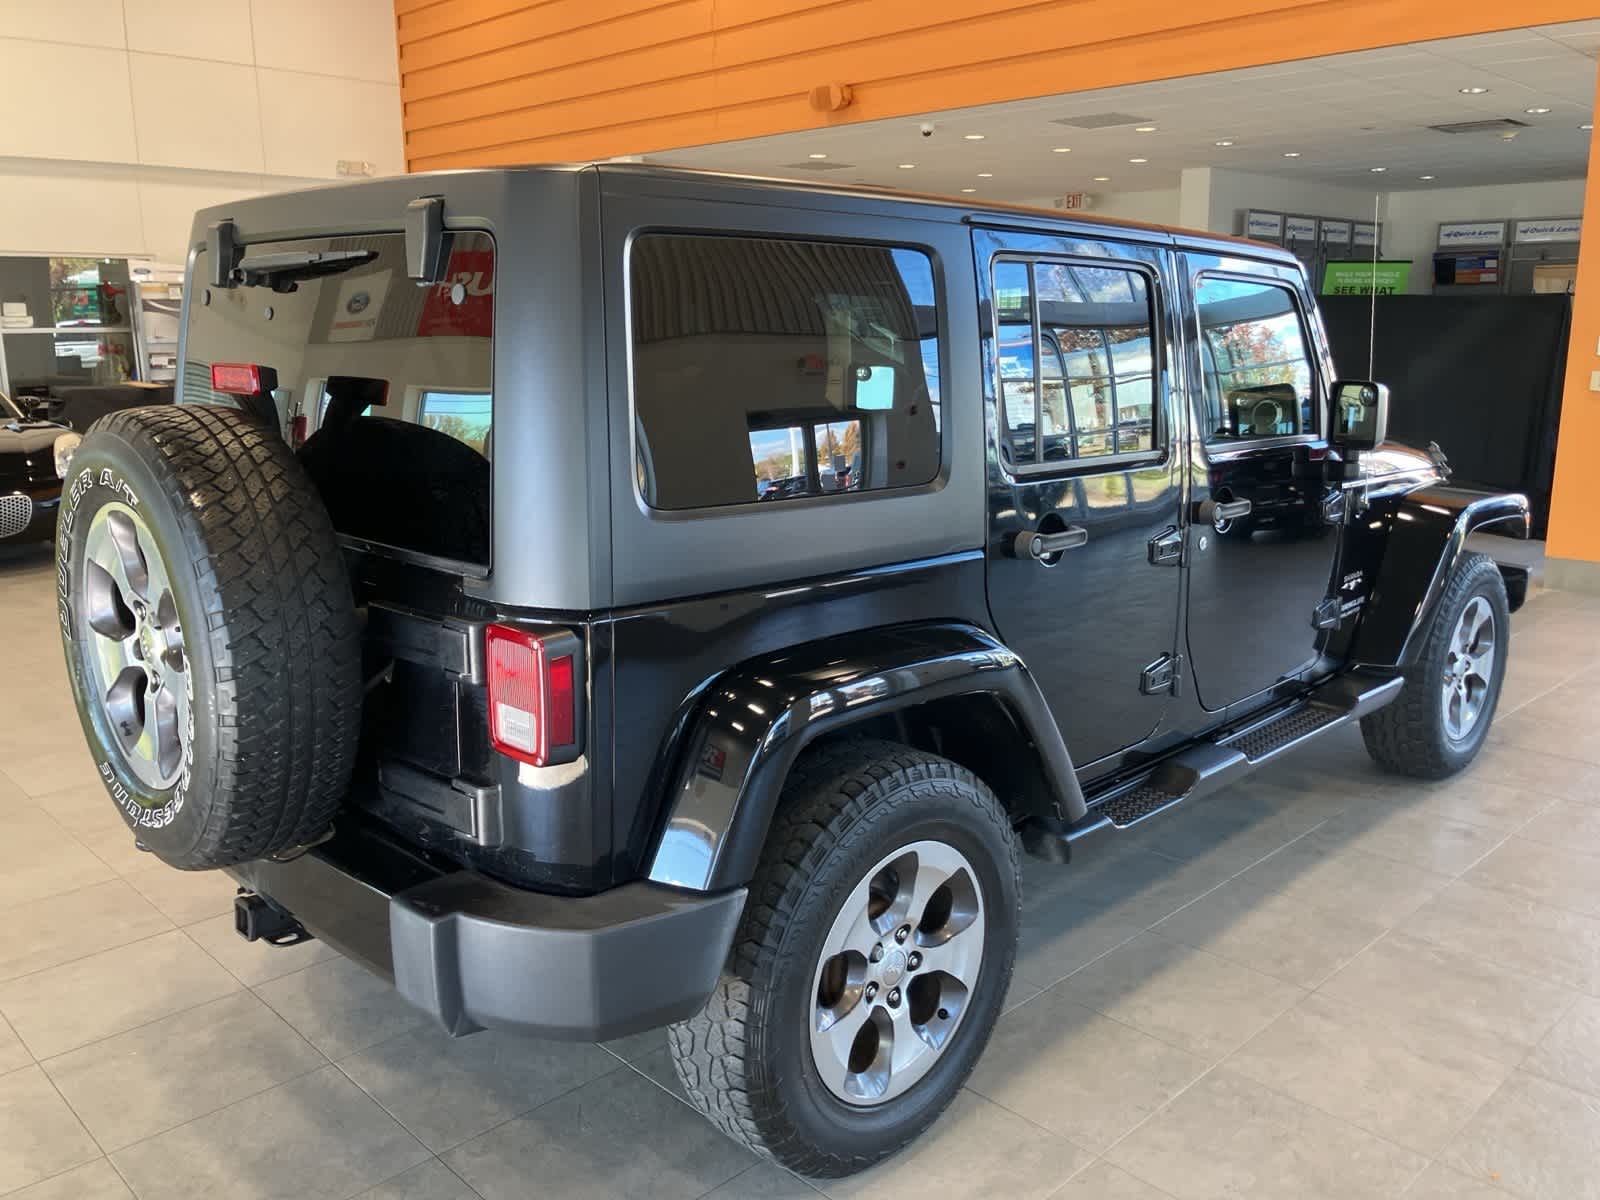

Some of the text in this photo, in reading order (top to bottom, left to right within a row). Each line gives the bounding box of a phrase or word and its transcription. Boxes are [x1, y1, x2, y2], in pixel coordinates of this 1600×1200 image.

[1066, 193, 1082, 209] EXIT
[1453, 229, 1477, 238] Quick
[1529, 226, 1555, 234] Quick
[1334, 286, 1396, 296] SEE WHAT
[58, 468, 93, 641] DUELER
